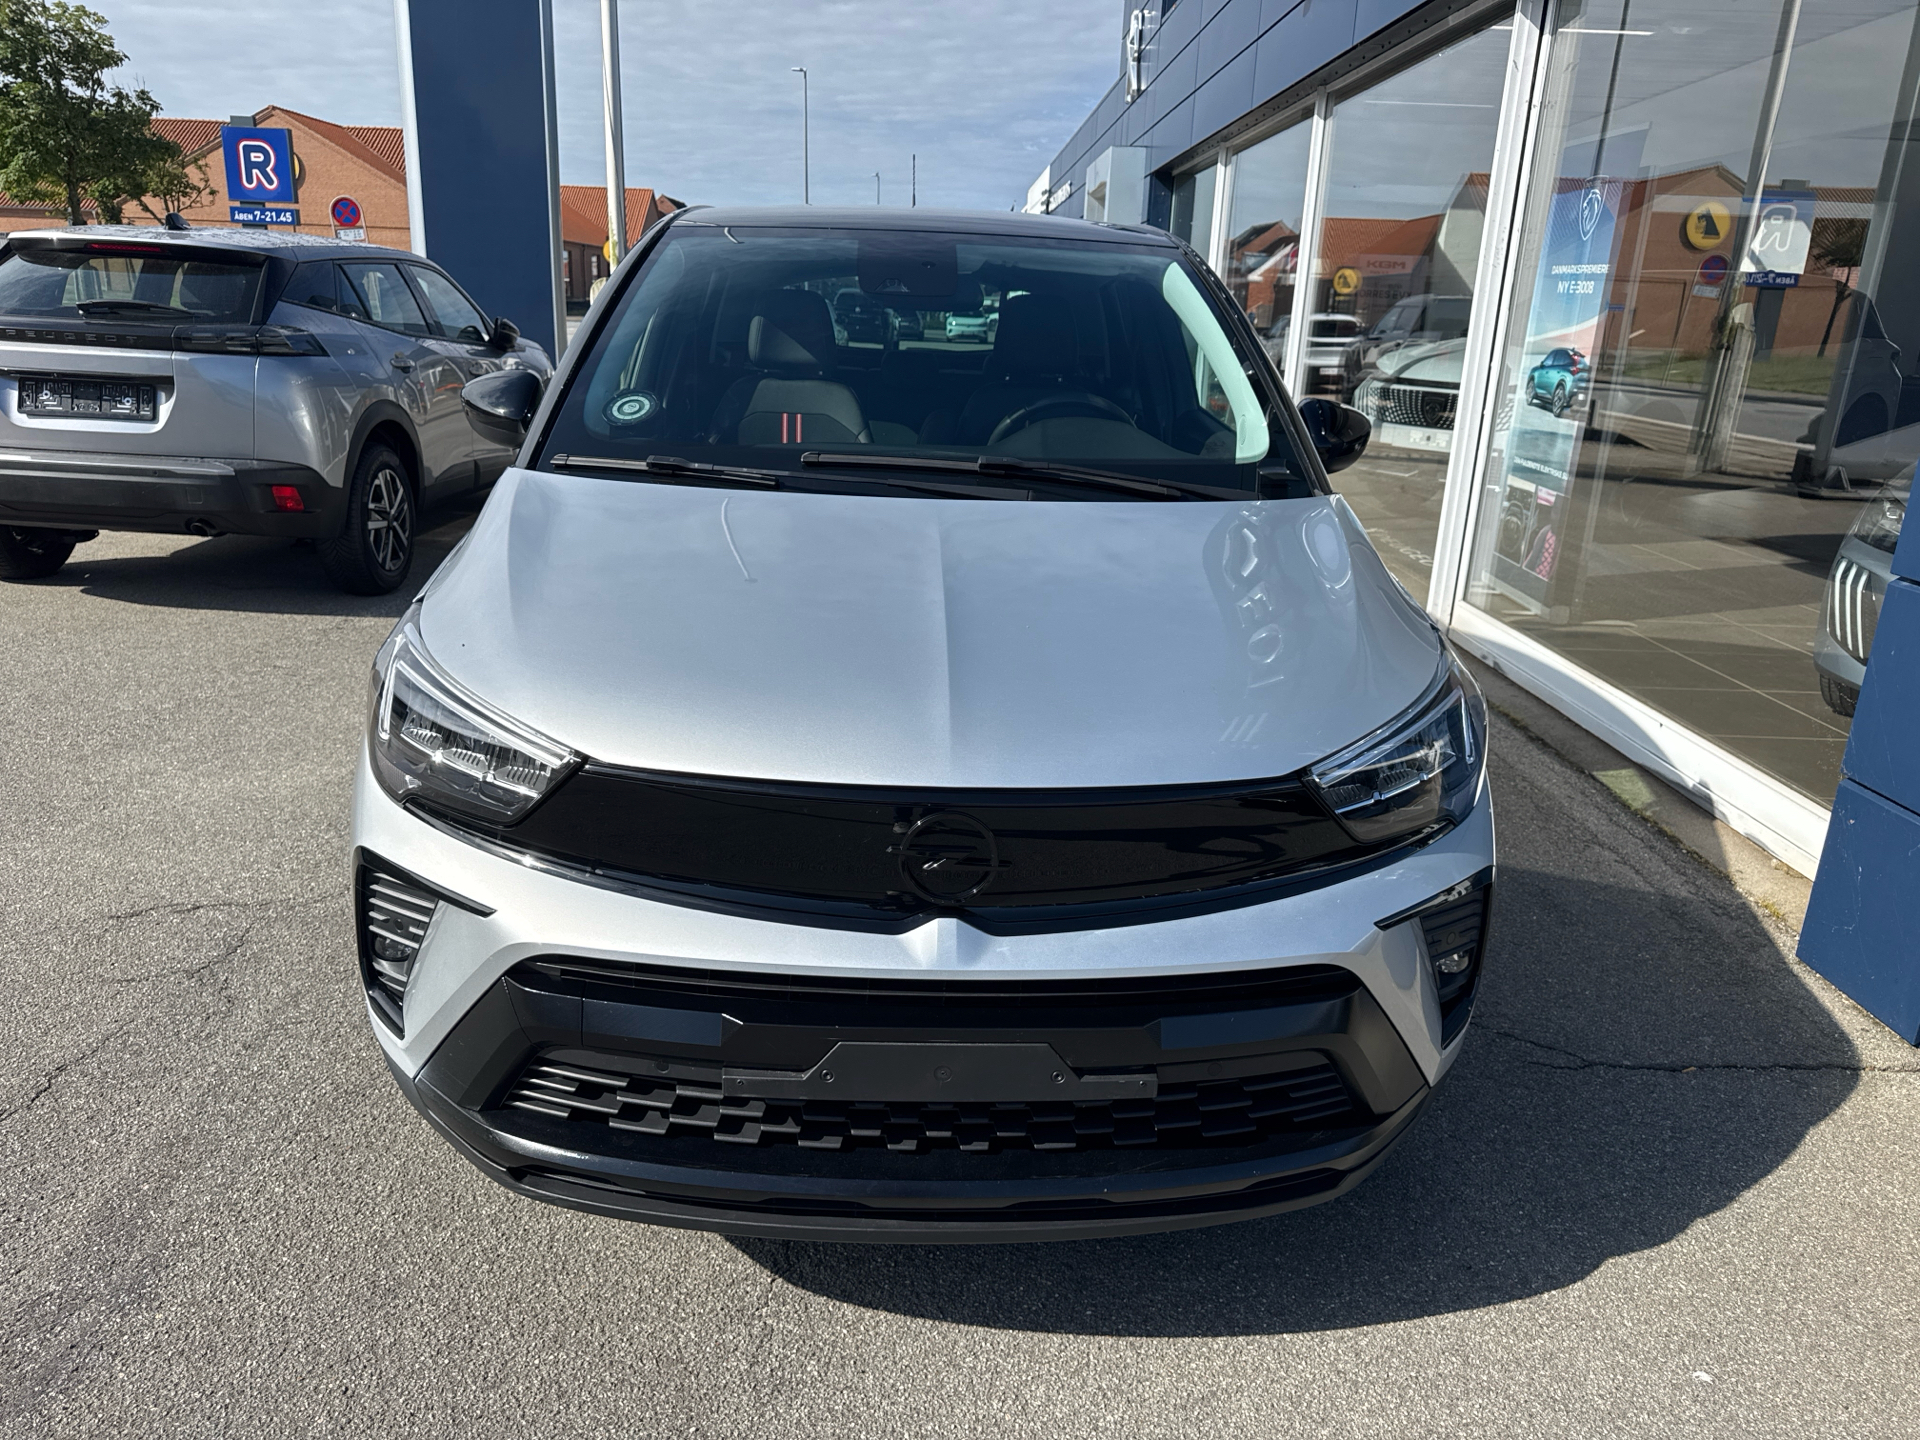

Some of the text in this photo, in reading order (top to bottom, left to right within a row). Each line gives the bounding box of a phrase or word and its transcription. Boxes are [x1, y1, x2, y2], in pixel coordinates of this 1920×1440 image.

[238, 139, 279, 190] R
[233, 210, 293, 223] ÅBEN 7-21.45
[1366, 260, 1406, 269] KGM
[1355, 288, 1391, 299] ORRES
[1557, 280, 1595, 294] NY E-3008
[5, 329, 138, 344] PEUGEOT
